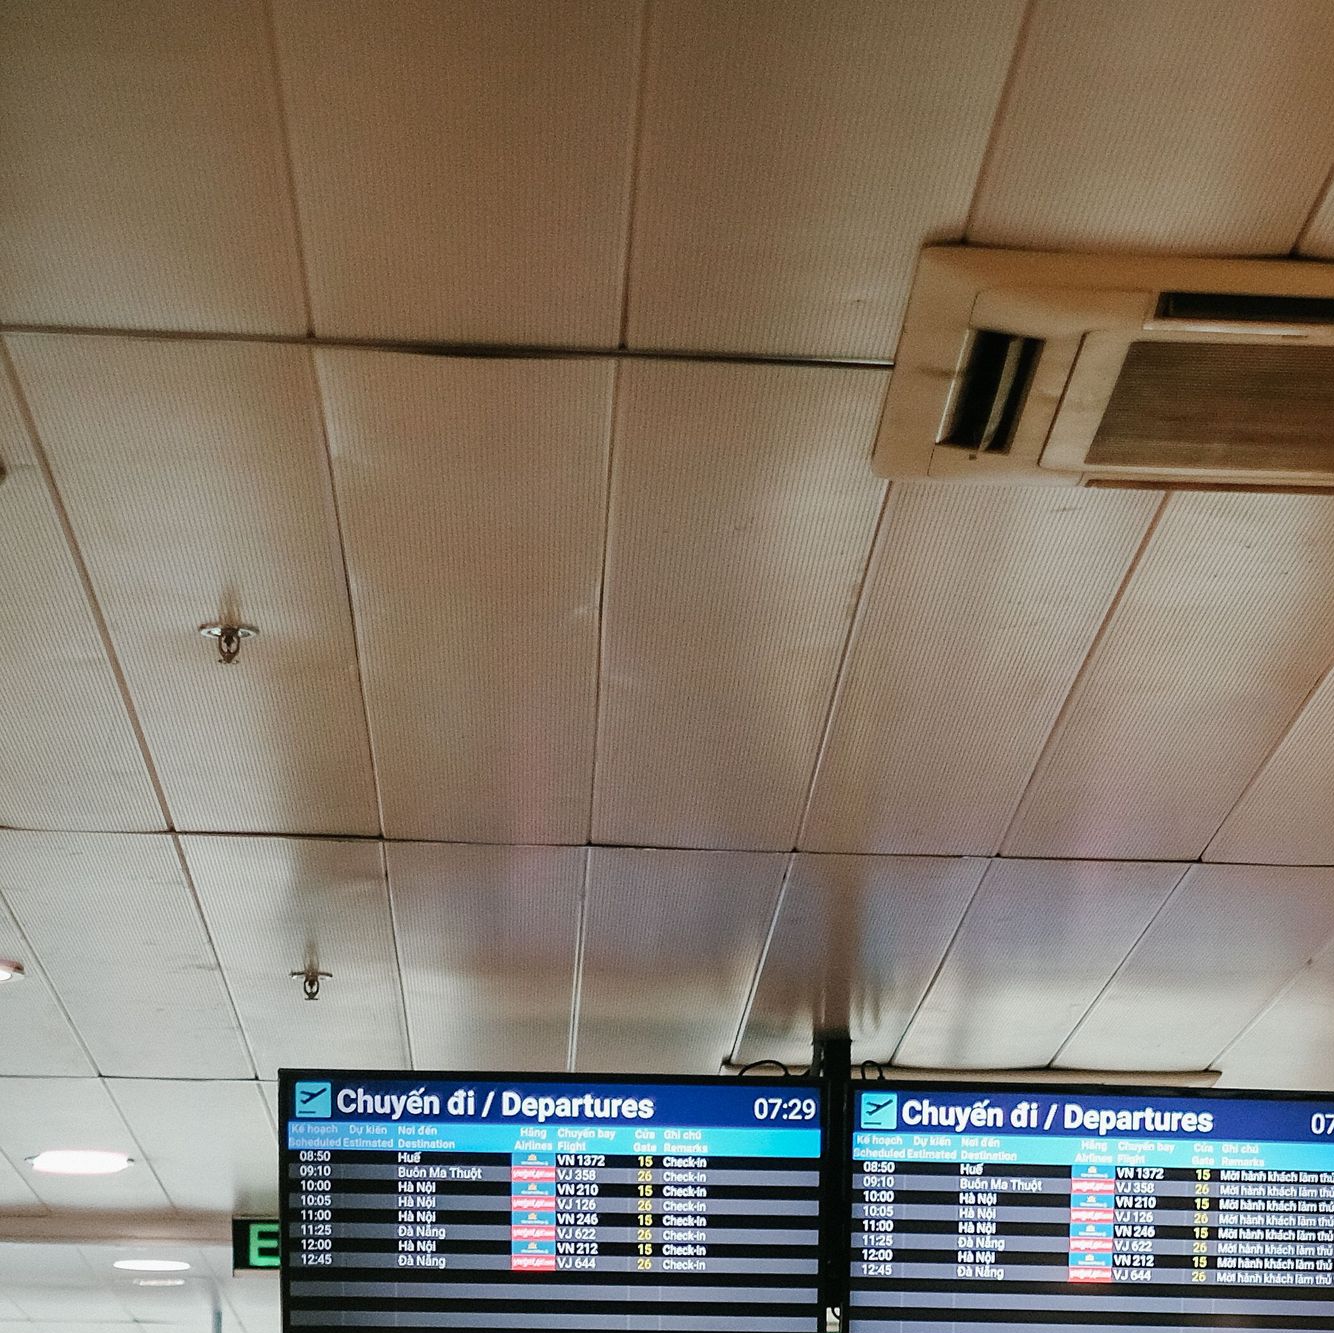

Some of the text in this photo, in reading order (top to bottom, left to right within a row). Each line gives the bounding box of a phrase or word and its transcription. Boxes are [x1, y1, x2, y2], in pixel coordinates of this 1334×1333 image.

[337, 1087, 439, 1120] Chuyến
[447, 1089, 475, 1116] đi
[502, 1094, 654, 1124] Departures
[754, 1098, 816, 1120] 07:29
[902, 1100, 1003, 1133] Chuyến
[1010, 1103, 1038, 1129] đi
[1064, 1104, 1213, 1136] Departures
[300, 1151, 331, 1162] 08:50
[557, 1154, 575, 1166] VN
[577, 1155, 605, 1167] 1372
[638, 1156, 653, 1167] 15
[663, 1156, 707, 1168] Check-in
[300, 1166, 331, 1177] 09:10
[429, 1168, 447, 1178] Ma
[557, 1169, 573, 1180] VJ
[575, 1169, 596, 1181] 358
[638, 1170, 653, 1182] 26
[663, 1171, 707, 1183] Check-in
[863, 1162, 895, 1173] 08:50
[1117, 1167, 1134, 1179] VN
[1136, 1168, 1164, 1179] 1372
[1196, 1169, 1210, 1180] 15
[301, 1181, 331, 1191] 10:00
[557, 1184, 575, 1196] VN
[576, 1184, 599, 1196] 210
[638, 1185, 653, 1197] 15
[663, 1185, 707, 1197] Check-in
[863, 1176, 894, 1187] 09:10
[991, 1179, 1008, 1189] Ma
[1116, 1182, 1132, 1193] VJ
[1195, 1184, 1209, 1195] 26
[301, 1195, 331, 1206] 10:05
[557, 1198, 573, 1210] VJ
[575, 1199, 596, 1211] 126
[638, 1199, 653, 1211] 26
[663, 1200, 707, 1212] Check-in
[863, 1191, 894, 1202] 10:00
[1115, 1196, 1133, 1208] VN
[1134, 1196, 1156, 1208] 210
[1195, 1198, 1210, 1209] 15
[301, 1210, 331, 1221] 11:00
[557, 1213, 575, 1225] VN
[576, 1213, 599, 1226] 246
[638, 1214, 653, 1226] 15
[663, 1215, 707, 1227] Check-in
[863, 1205, 894, 1217] 10:05
[301, 1225, 332, 1236] 11:25
[557, 1228, 573, 1240] VJ
[575, 1228, 596, 1240] 622
[638, 1229, 653, 1241] 26
[663, 1229, 707, 1241] Check-in
[862, 1220, 894, 1232] 11:00
[301, 1239, 332, 1250] 12:00
[557, 1242, 575, 1254] VN
[576, 1243, 598, 1255] 212
[638, 1243, 653, 1256] 15
[663, 1244, 707, 1256] Check-in
[862, 1235, 893, 1246] 11:25
[301, 1254, 332, 1265] 12:45
[557, 1257, 573, 1269] VJ
[575, 1257, 596, 1269] 644
[638, 1258, 653, 1270] 26
[663, 1259, 707, 1270] Check-in
[862, 1250, 892, 1261] 12:00
[862, 1264, 892, 1275] 12:45
